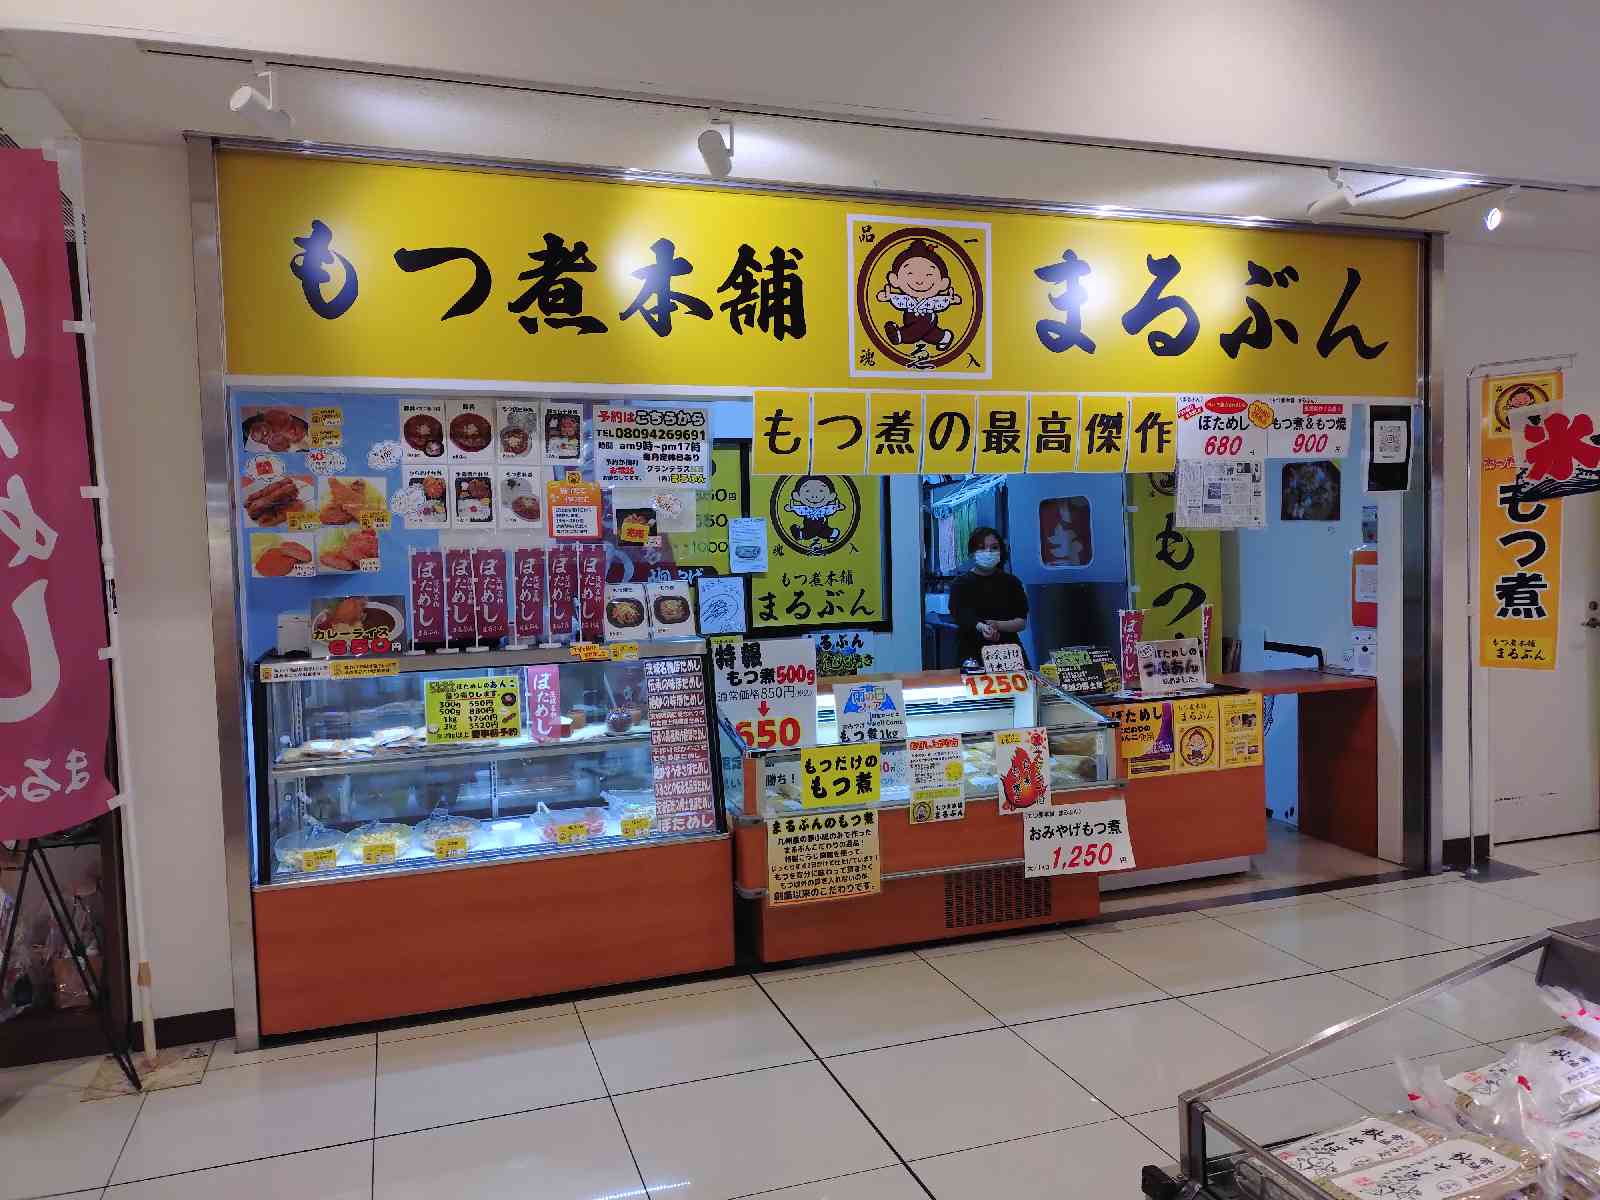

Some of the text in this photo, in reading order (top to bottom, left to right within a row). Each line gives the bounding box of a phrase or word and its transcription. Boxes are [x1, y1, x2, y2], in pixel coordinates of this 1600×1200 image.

[859, 224, 876, 243] 品
[290, 220, 807, 341] もつ煮本舗
[1034, 248, 1389, 360] まるぶん
[966, 352, 981, 369] 入
[598, 410, 706, 426] 予約はこちらから
[763, 408, 1174, 455] もつ煮の最高傑作
[1204, 435, 1244, 456] 680
[1292, 434, 1329, 453] 900
[1524, 413, 1600, 481] 氷
[1496, 482, 1549, 618] もつ煮
[782, 569, 854, 588] もつ煮本舗
[758, 588, 875, 621] まるぶん
[312, 626, 390, 641] カレーライス
[965, 674, 1029, 696] 1250
[736, 717, 801, 749] 650
[804, 754, 878, 775] もつだけの
[810, 771, 873, 799] もつ煮
[771, 811, 875, 835] まるぶんのもつ煮
[1029, 819, 1123, 842] おみやげもつ煮
[1052, 842, 1113, 870] 1,250
